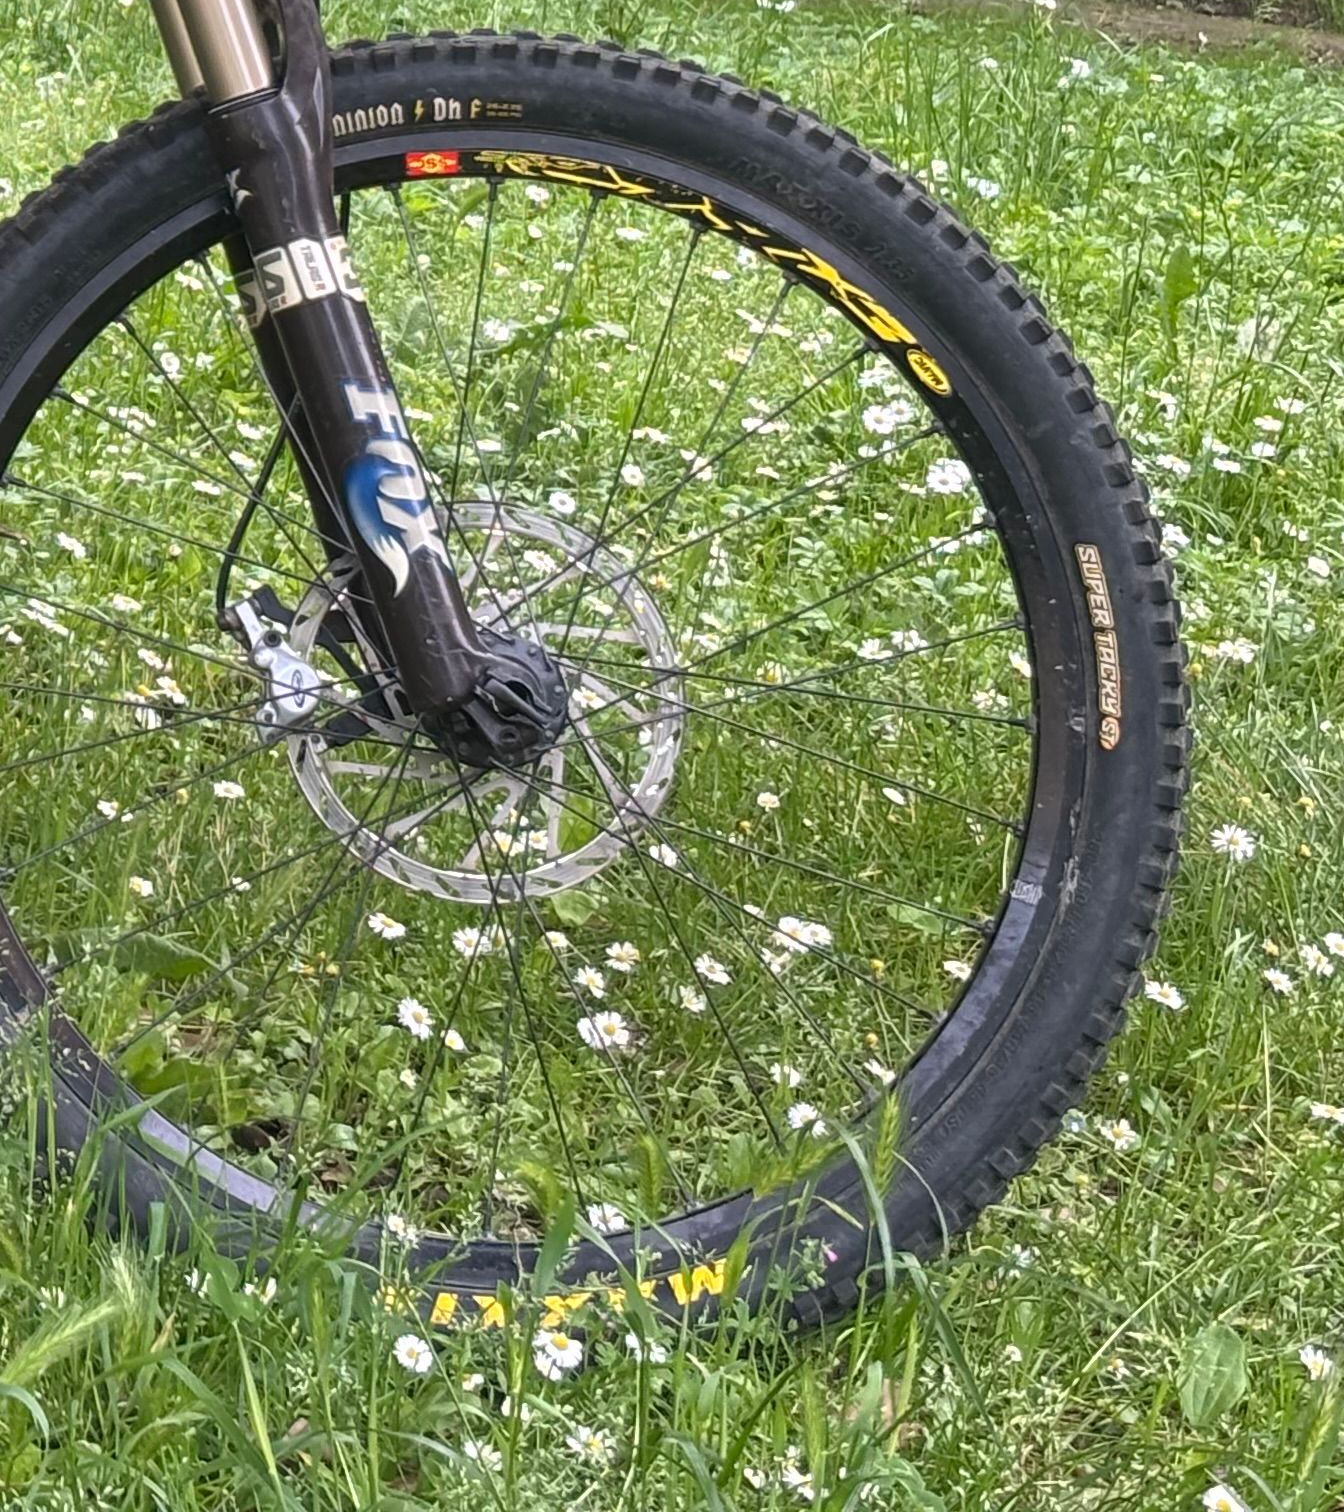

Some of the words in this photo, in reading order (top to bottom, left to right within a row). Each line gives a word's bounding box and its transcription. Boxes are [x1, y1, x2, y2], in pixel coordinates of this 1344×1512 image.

[342, 380, 453, 574] FOX
[1074, 543, 1114, 629] SUPER
[1093, 629, 1122, 719] TACKY
[376, 1256, 728, 1328] MAXXI
